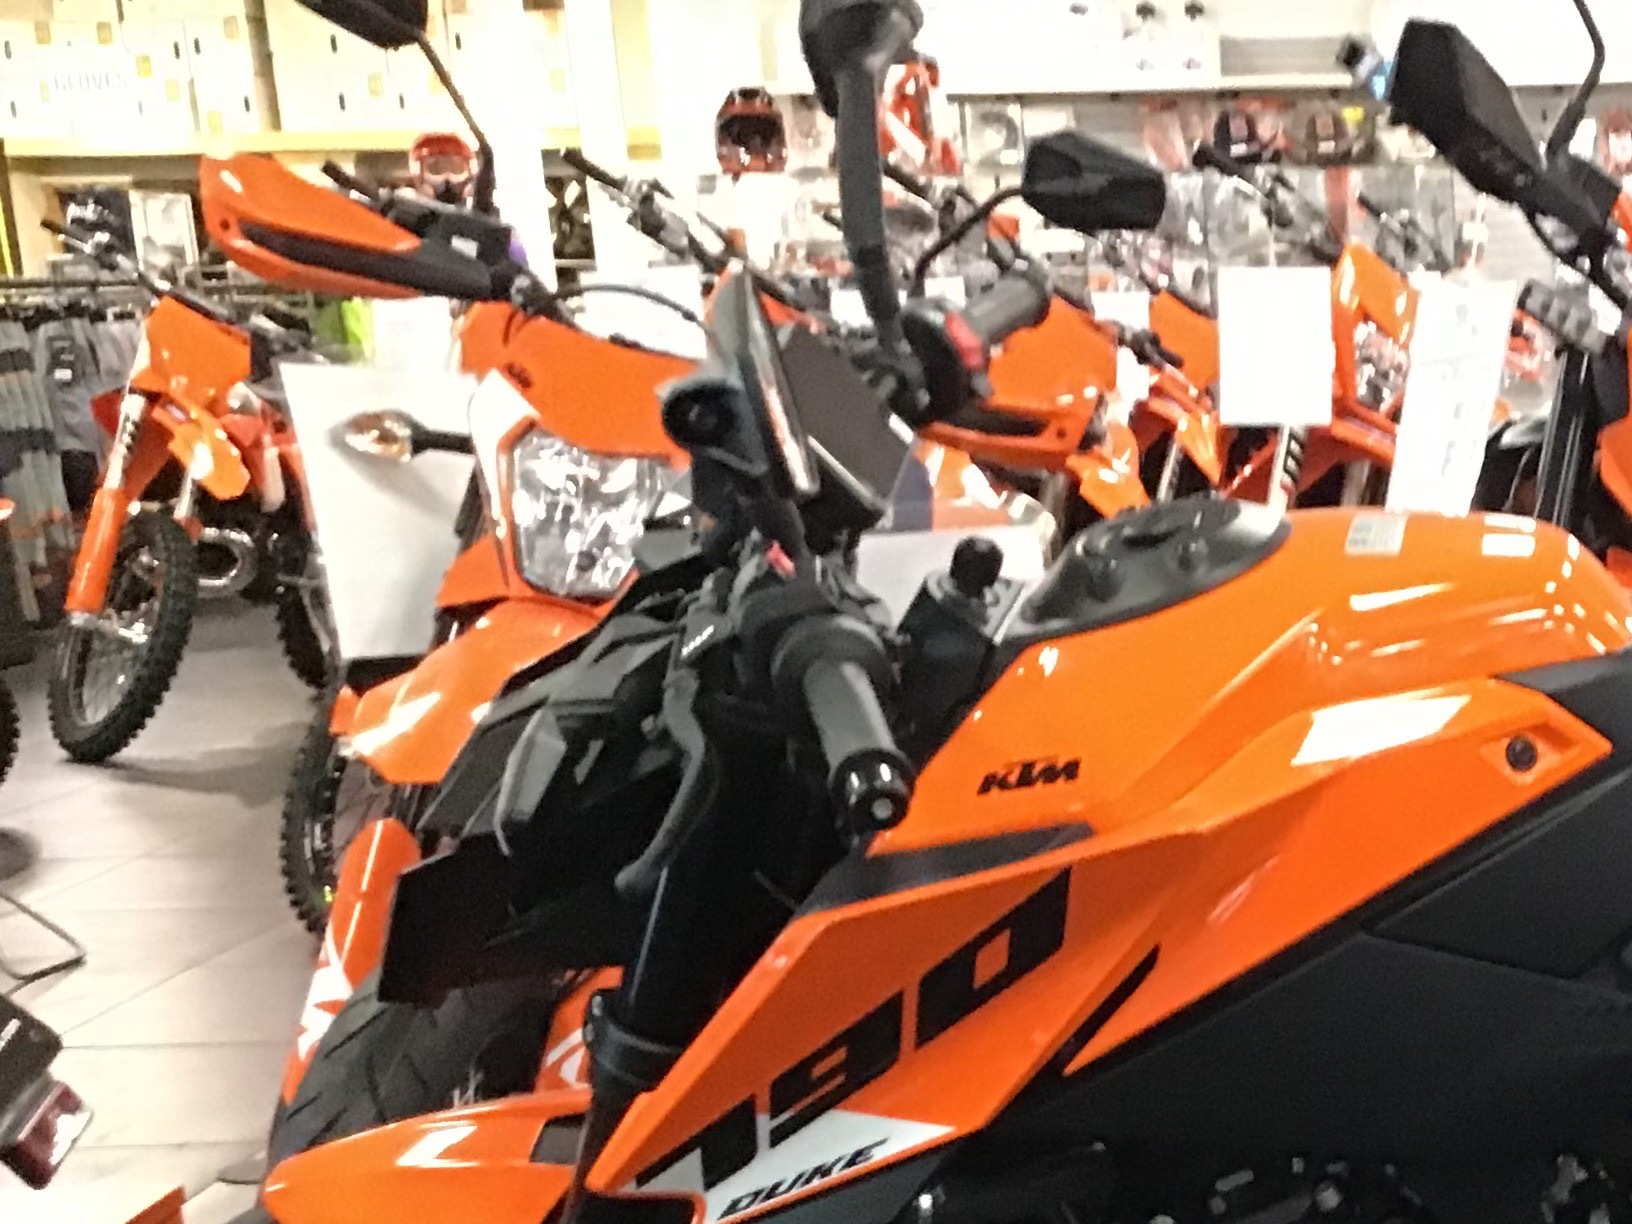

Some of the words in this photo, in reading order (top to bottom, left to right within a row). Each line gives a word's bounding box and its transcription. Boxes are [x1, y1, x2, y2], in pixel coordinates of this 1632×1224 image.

[976, 756, 1082, 796] KTM
[637, 866, 1071, 1192] 790
[716, 1137, 889, 1221] DUKE
